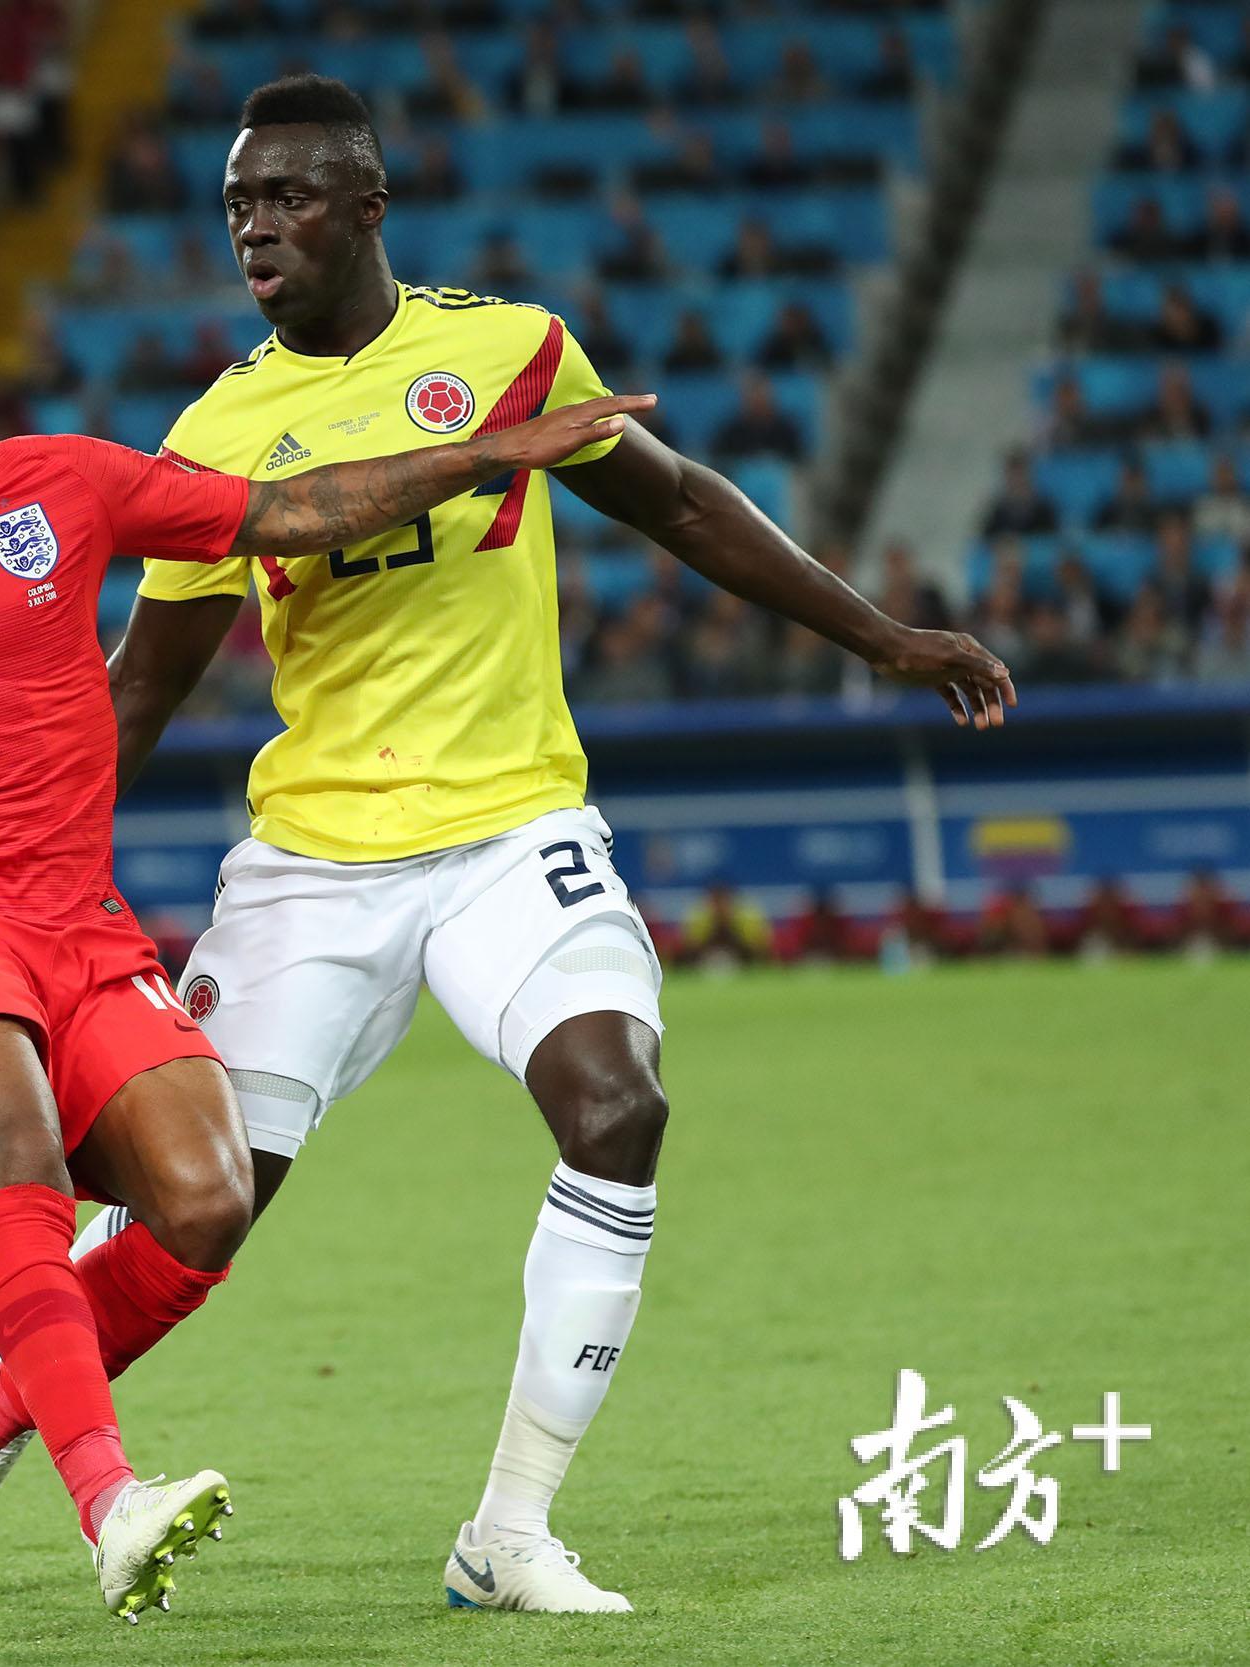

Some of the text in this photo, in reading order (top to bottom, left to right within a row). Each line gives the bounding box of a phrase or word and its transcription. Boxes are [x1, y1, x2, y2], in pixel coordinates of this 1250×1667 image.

[266, 448, 312, 471] adidas
[27, 581, 55, 597] COLOMBIA
[34, 595, 45, 606] JULY
[573, 1344, 621, 1372] FCF
